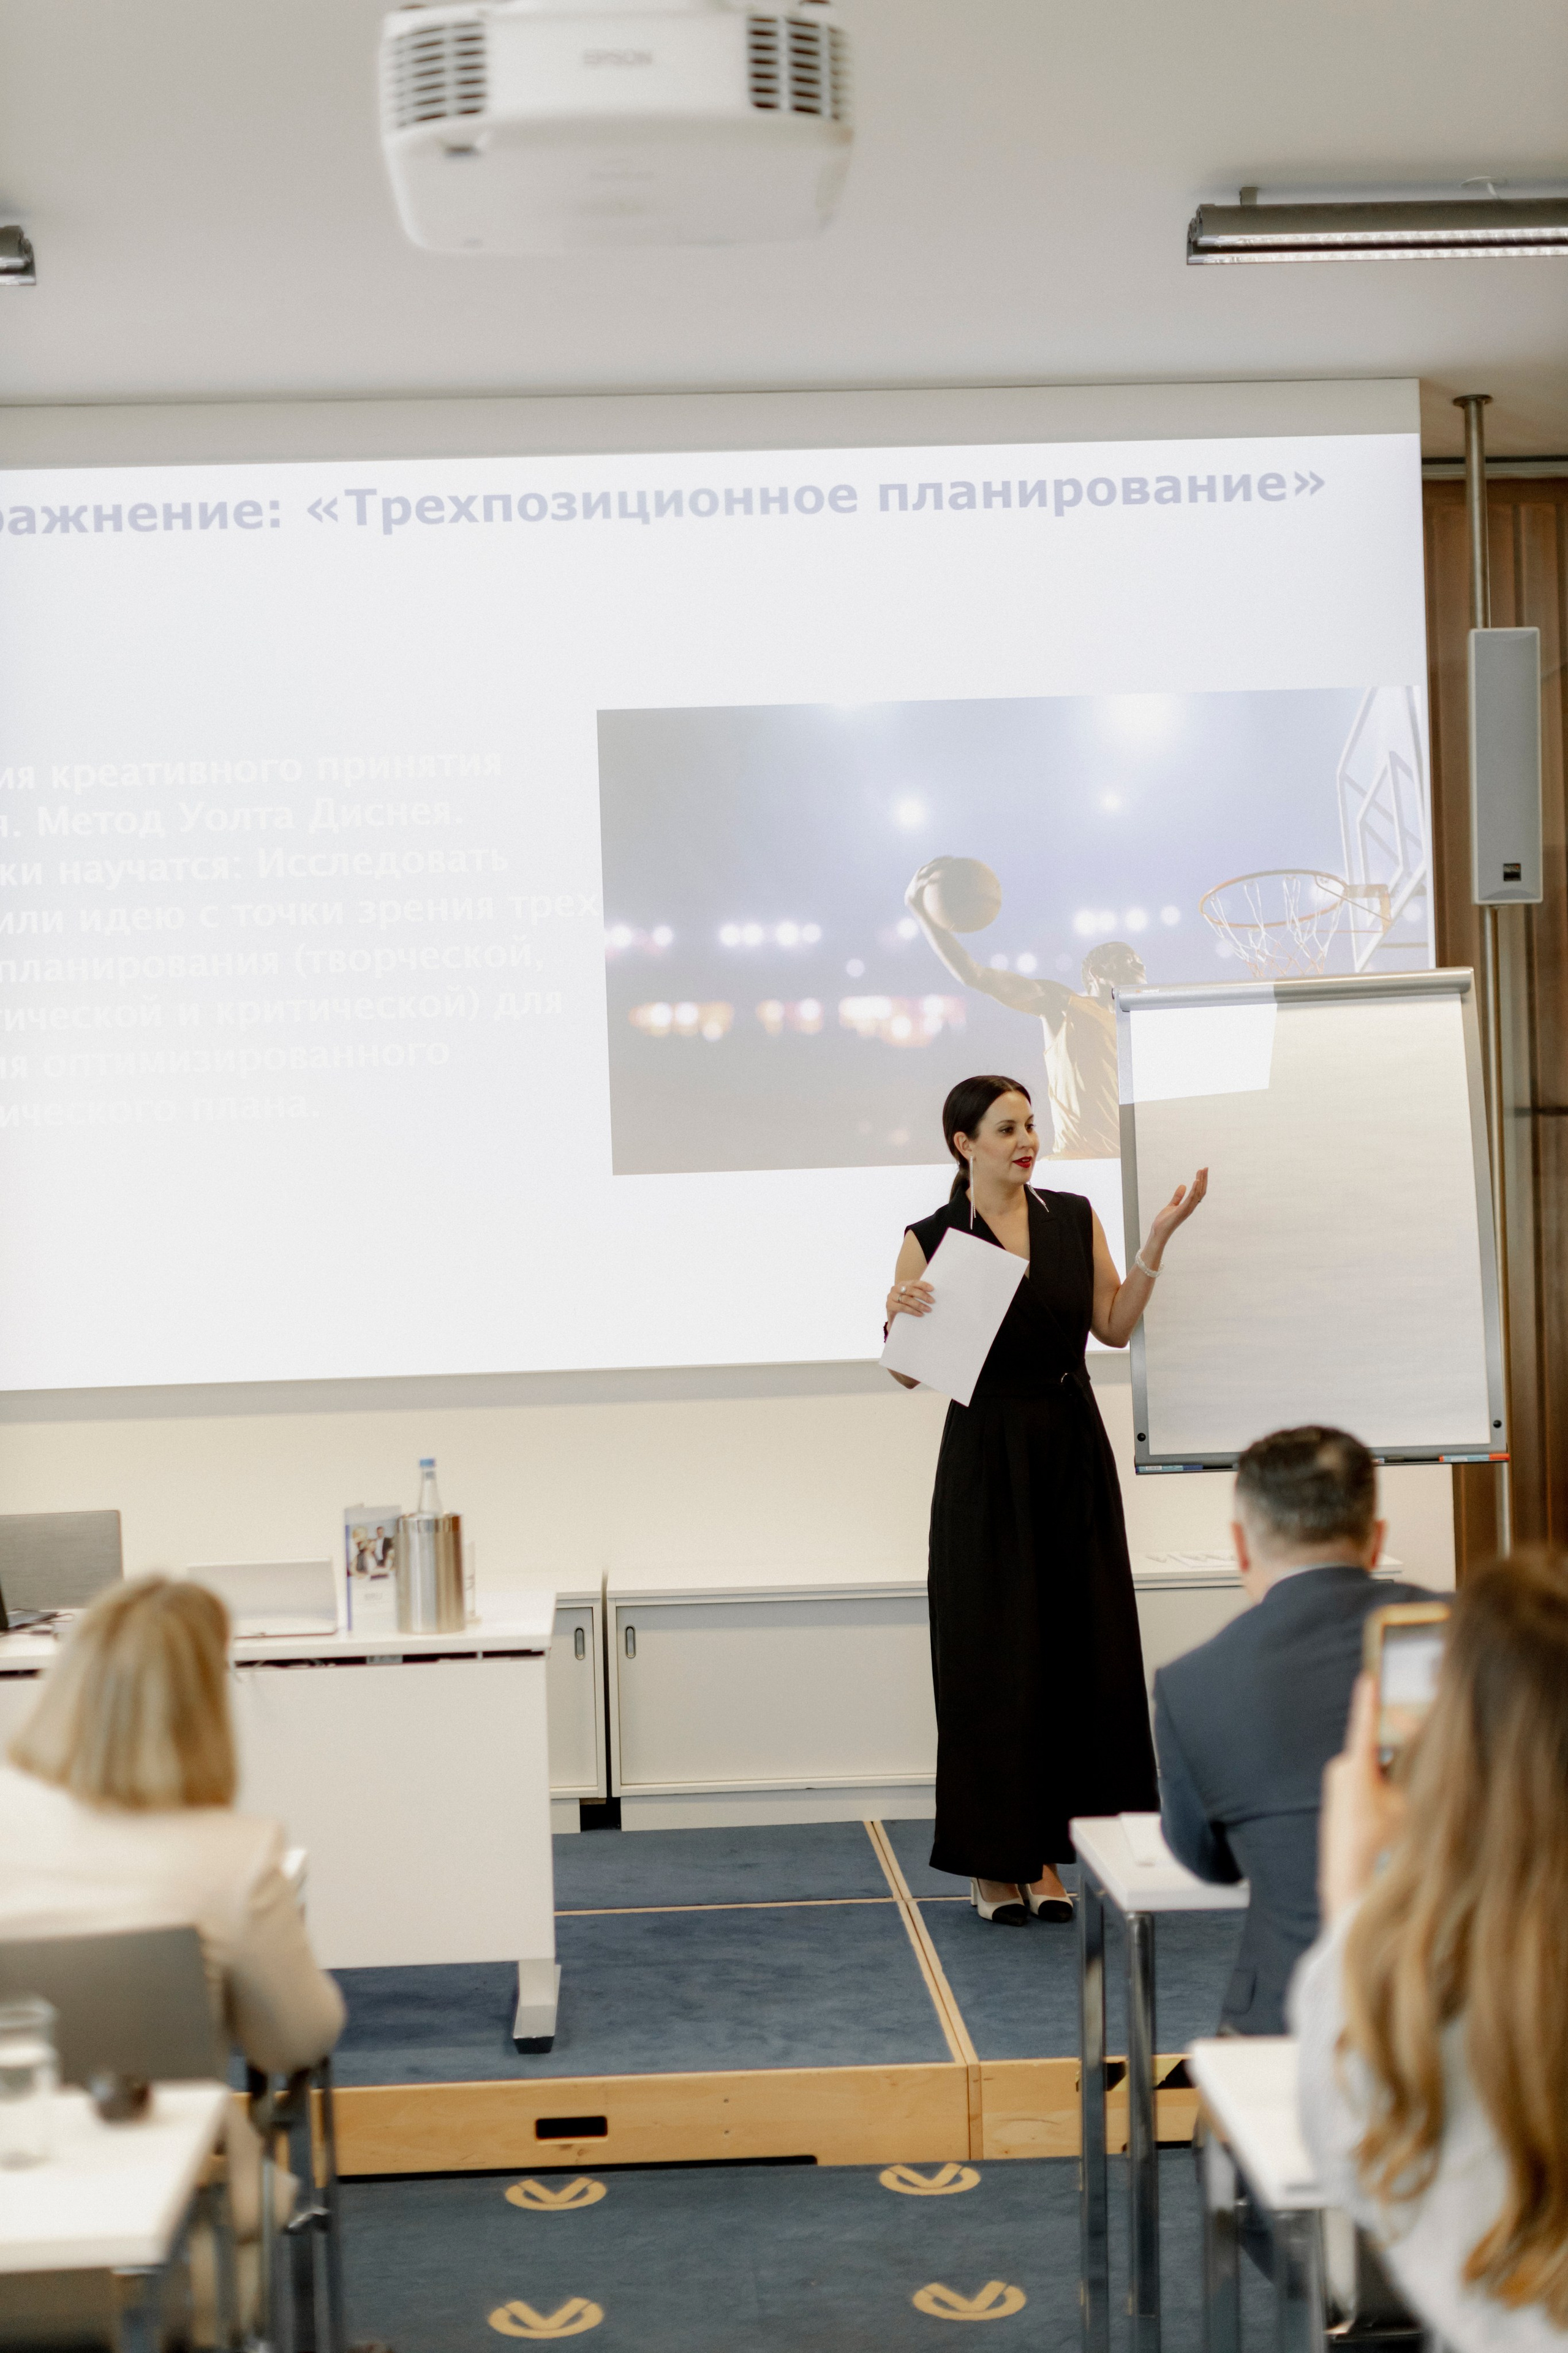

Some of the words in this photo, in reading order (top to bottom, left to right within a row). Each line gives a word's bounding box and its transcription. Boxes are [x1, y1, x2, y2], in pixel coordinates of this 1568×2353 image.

[306, 483, 858, 535] «Трехпозиционное
[878, 470, 1326, 518] планирование»
[51, 758, 303, 796] креативного
[317, 752, 502, 788] принятия
[37, 804, 166, 839] Метод
[178, 800, 295, 833] Уолта
[308, 797, 464, 834] Диснея.
[0, 862, 42, 886] ки
[59, 856, 242, 891] научатся:
[257, 847, 508, 880] Исследовать
[79, 906, 185, 937] идею
[199, 905, 219, 929] с
[230, 901, 344, 927] точки
[358, 896, 493, 931] зрения
[507, 892, 600, 926] трех
[0, 951, 279, 988] планирования
[294, 934, 544, 980] (творческой,
[0, 994, 162, 1032] ической
[178, 1003, 200, 1027] и
[216, 985, 480, 1032] критической)
[493, 990, 562, 1022] для
[43, 1041, 450, 1080] оптимизированного
[192, 1095, 320, 1122] плана.
